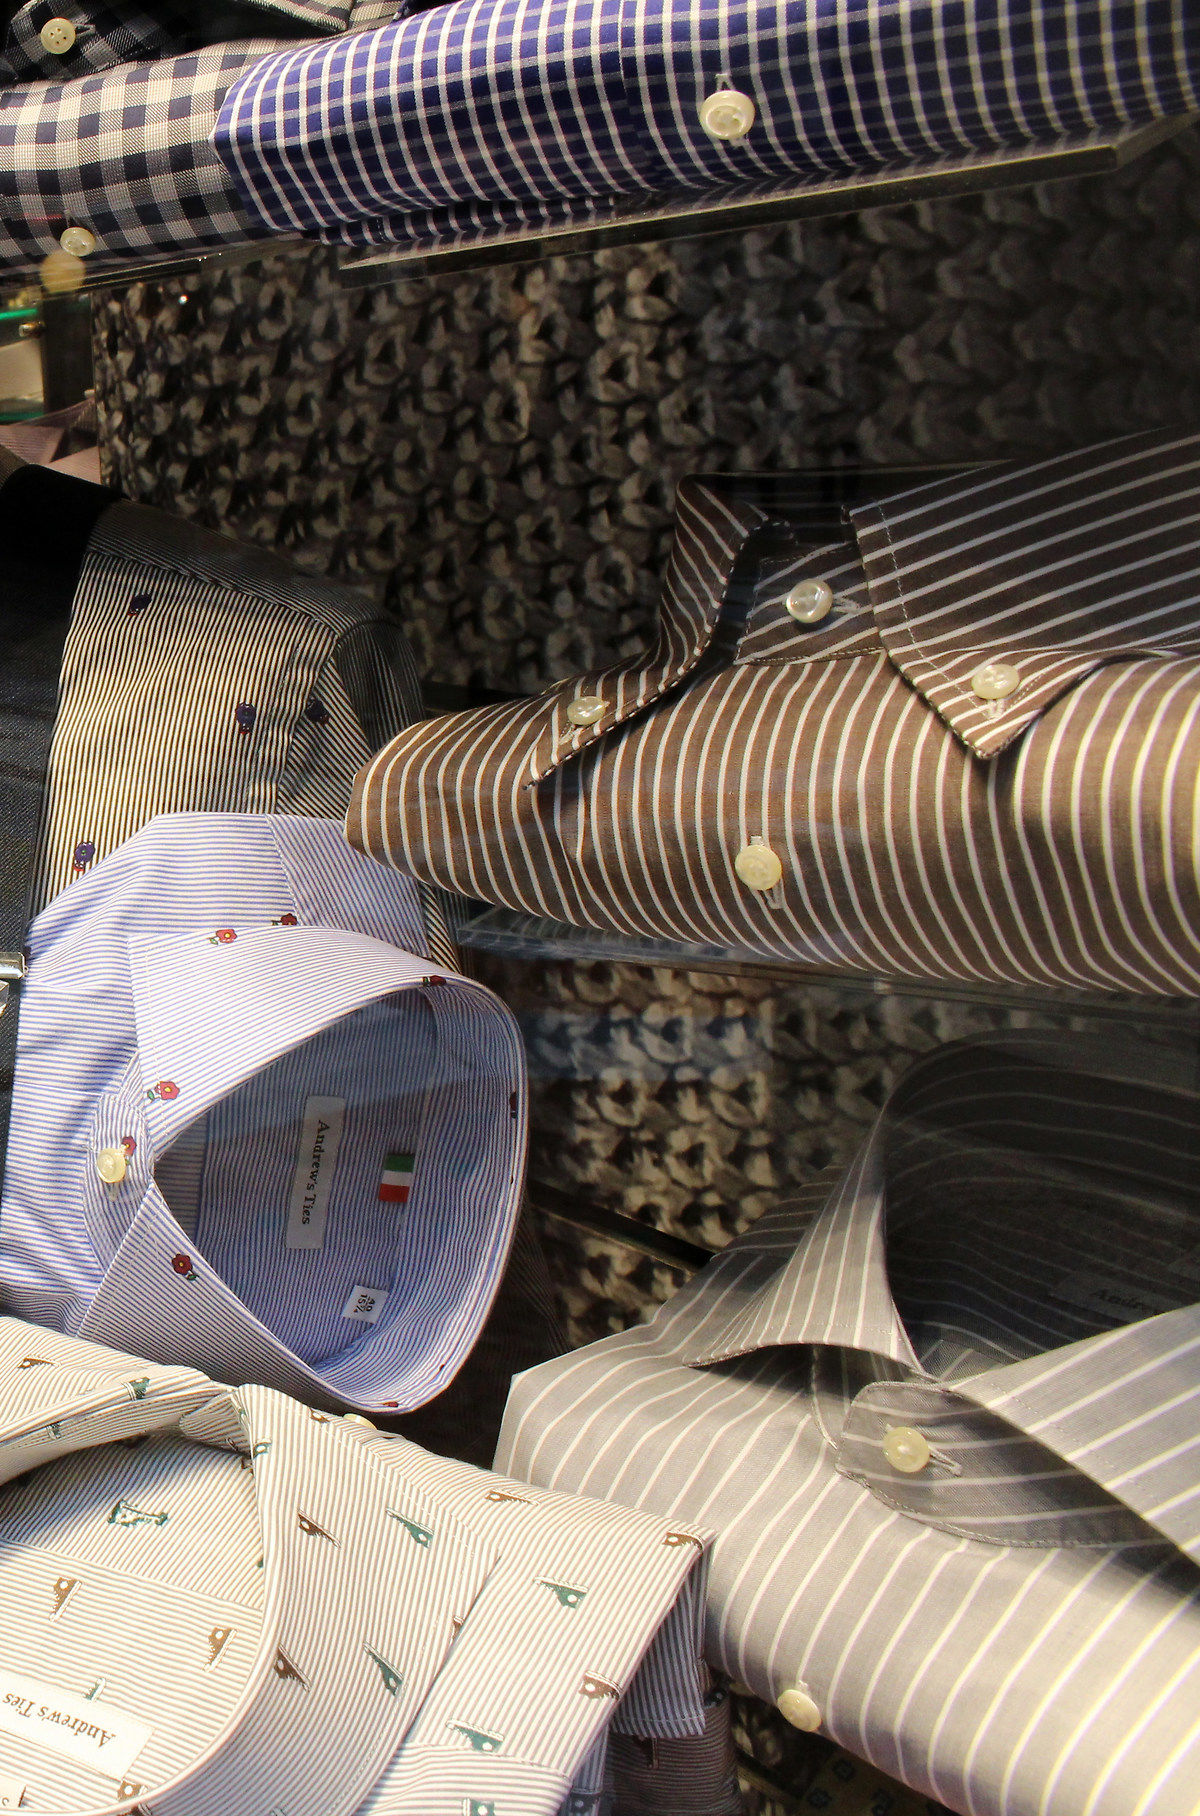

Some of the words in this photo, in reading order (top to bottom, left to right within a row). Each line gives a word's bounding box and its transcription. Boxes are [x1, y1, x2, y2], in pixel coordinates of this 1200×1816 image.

[306, 1119, 330, 1191] Andrew's
[301, 1194, 317, 1226] Ties
[2, 1692, 36, 1718] Ties
[37, 1705, 117, 1748] Andrew's
